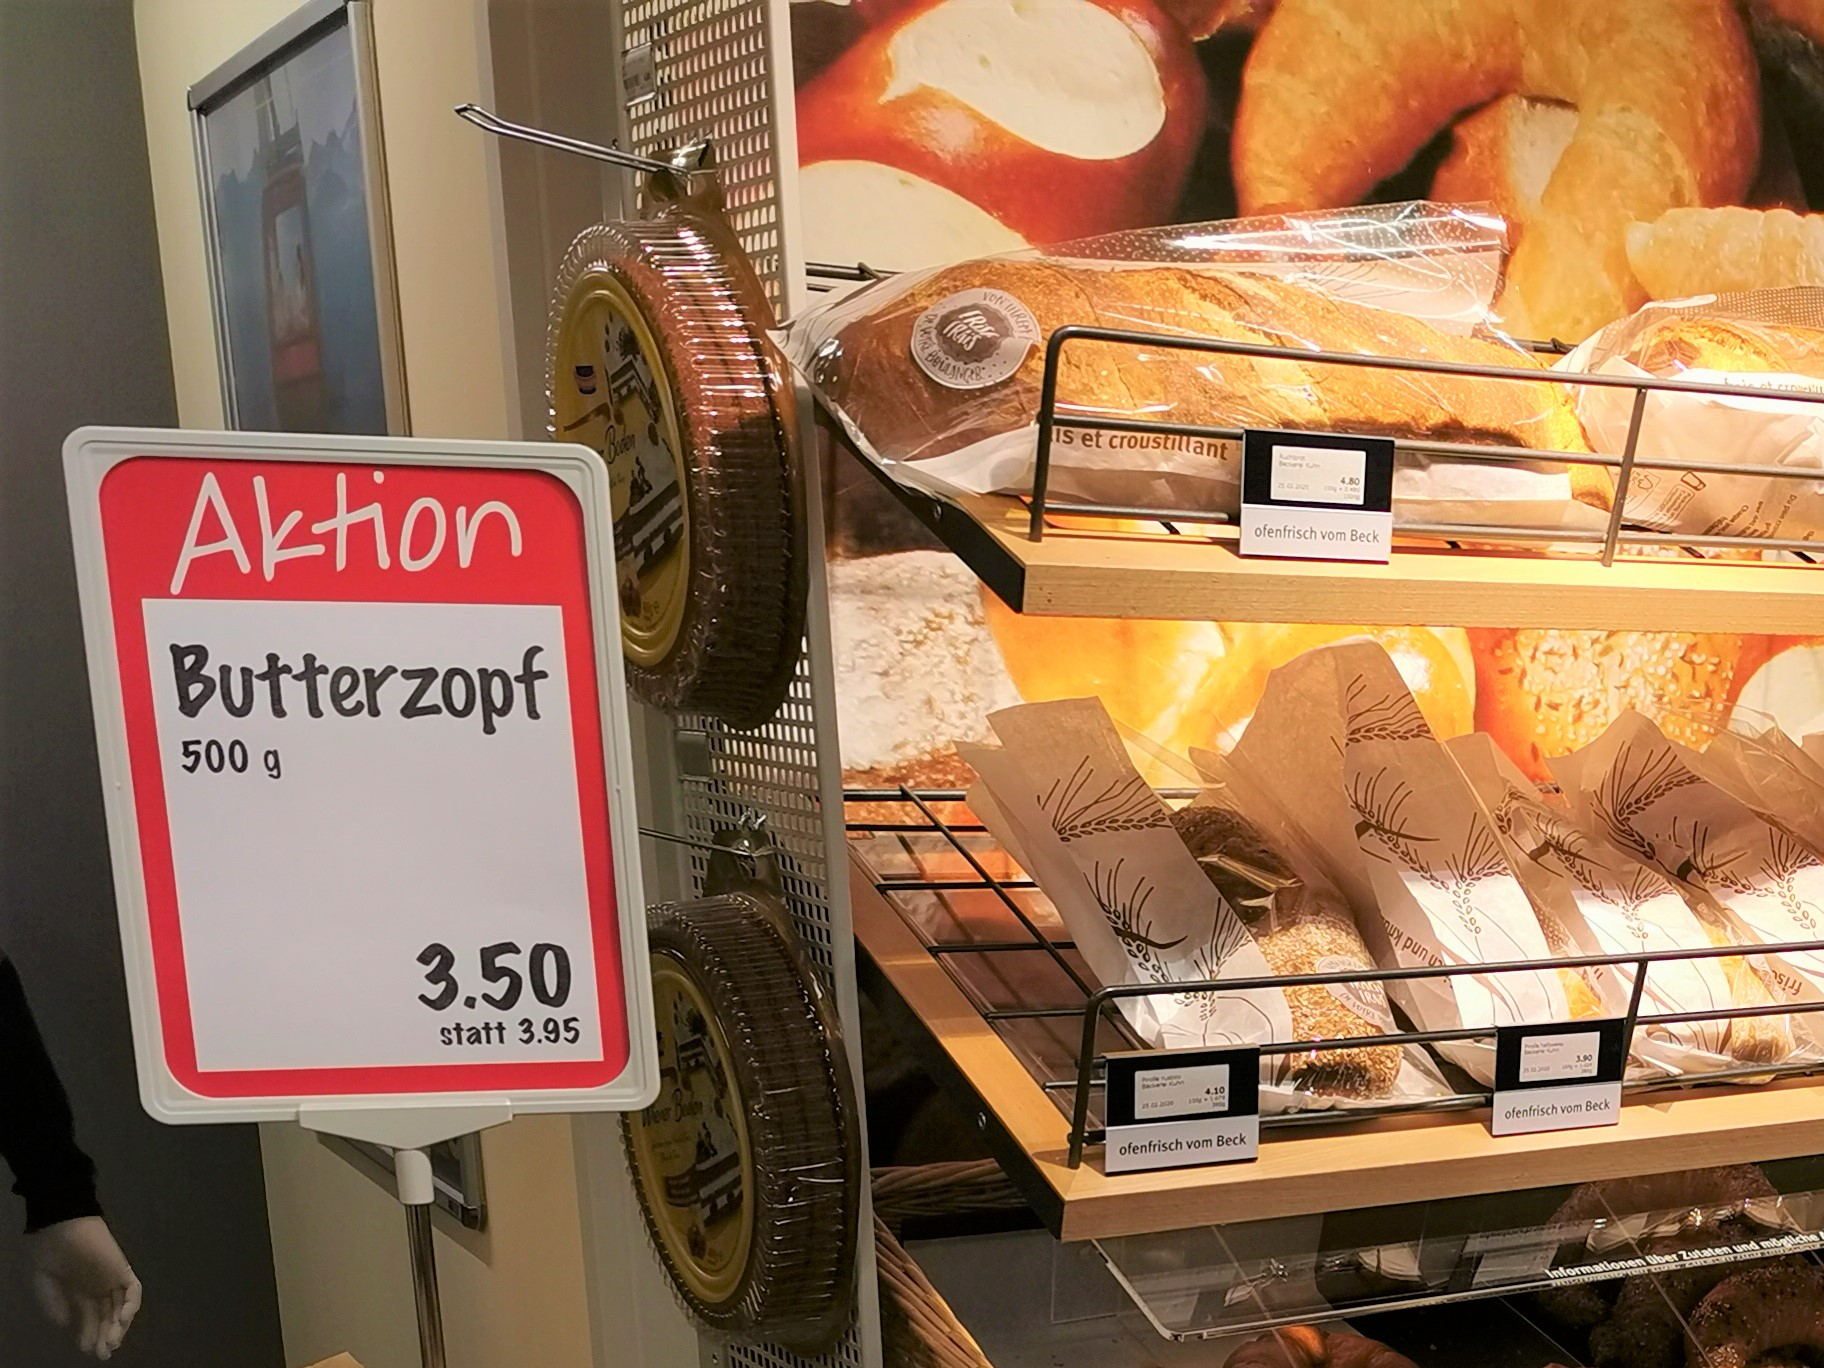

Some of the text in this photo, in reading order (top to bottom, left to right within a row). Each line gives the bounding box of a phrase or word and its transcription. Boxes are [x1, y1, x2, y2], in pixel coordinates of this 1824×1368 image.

[1081, 428, 1102, 449] et
[1109, 430, 1228, 461] croustillant
[1340, 476, 1361, 487] 4.80
[170, 470, 522, 595] Aktion
[1254, 517, 1380, 543] ofenfrisch vom Beck
[169, 642, 549, 735] Butterzopf
[181, 739, 282, 780] 500 g
[416, 941, 571, 1011] 3.50
[440, 1017, 580, 1047] statt 3.95
[1575, 1054, 1592, 1063] 3.90
[1205, 1086, 1225, 1095] 4.10
[1504, 1098, 1611, 1120] ofenfrisch vom Beck
[1119, 1133, 1247, 1156] ofenfrisch vom Beck
